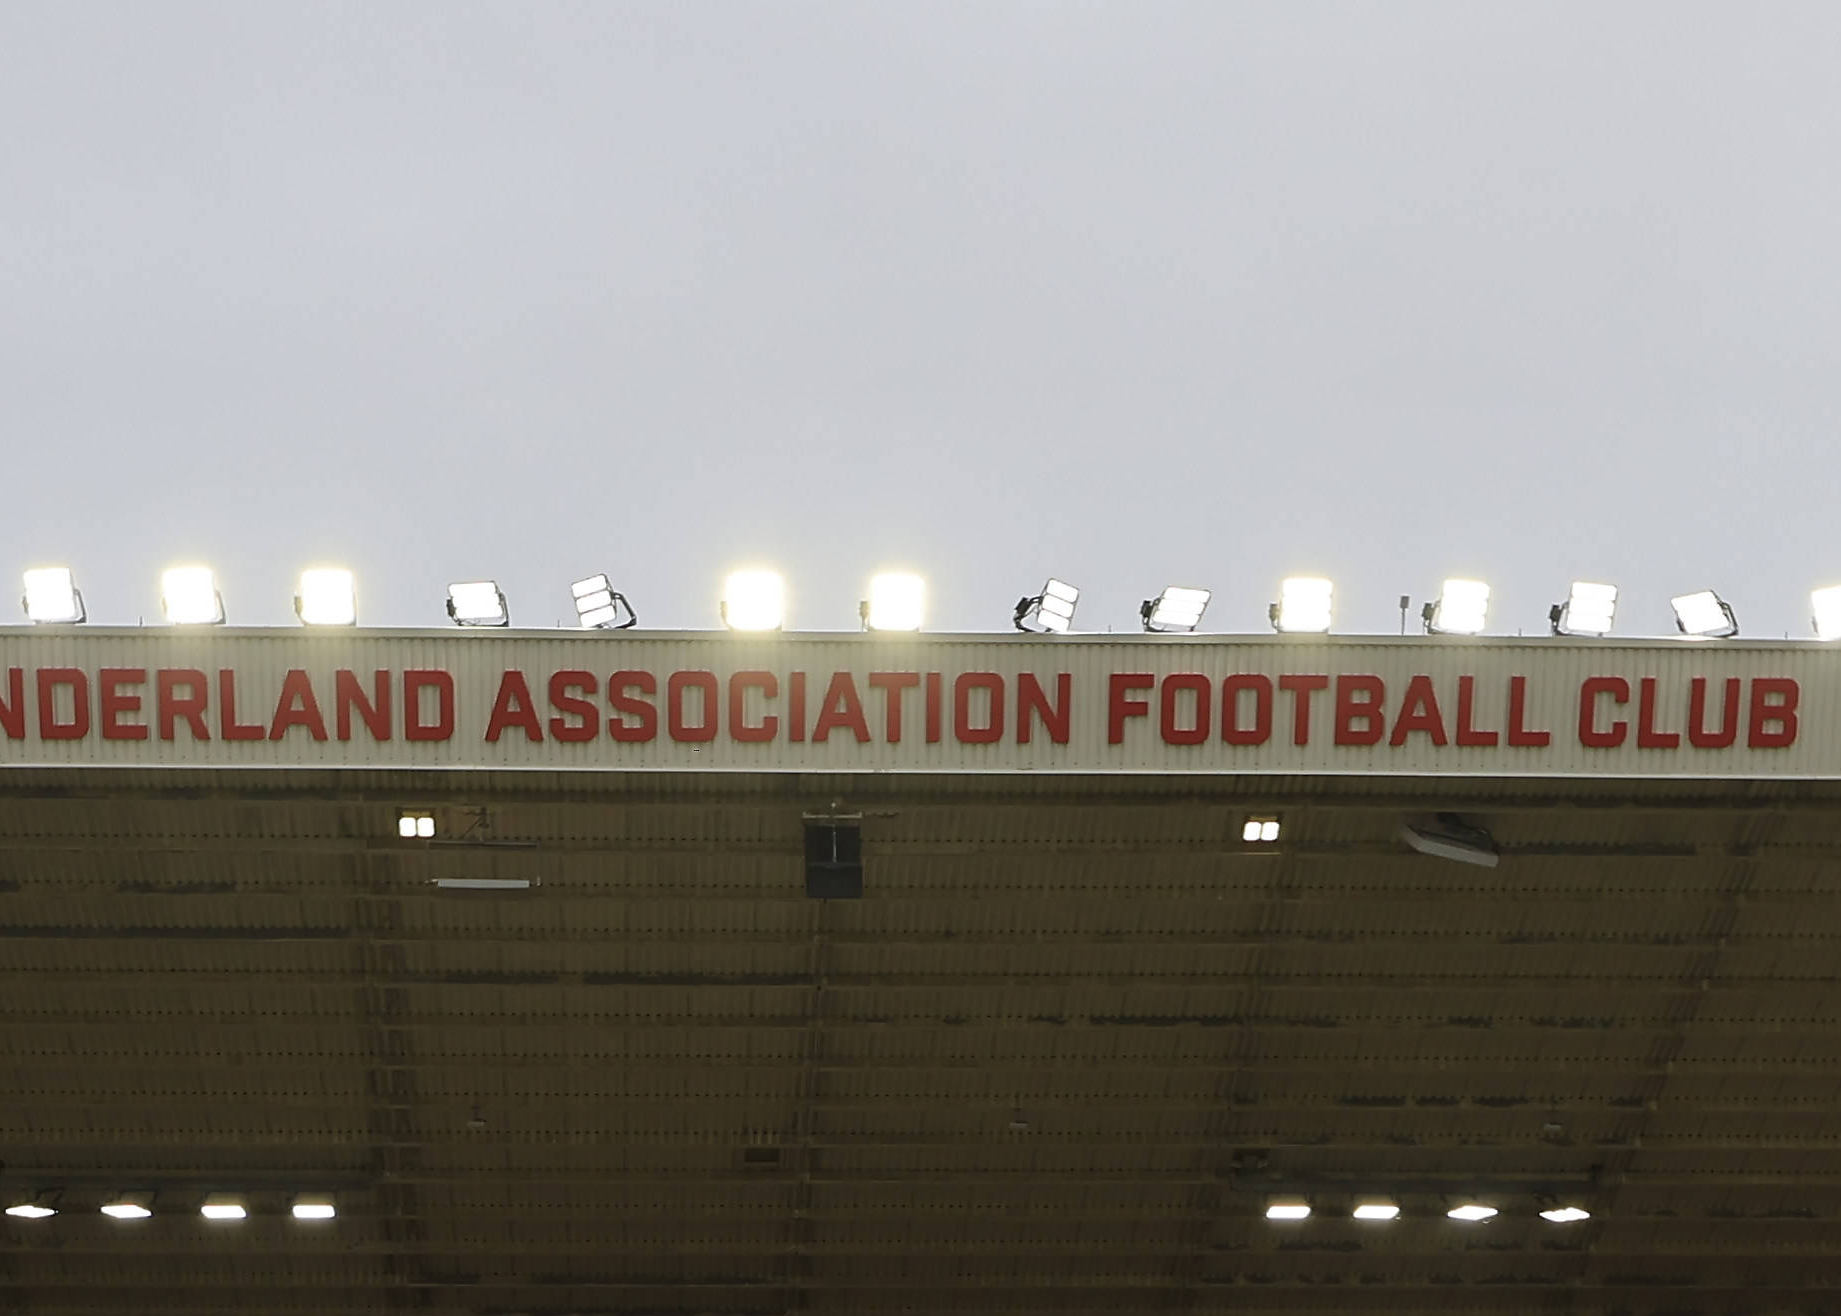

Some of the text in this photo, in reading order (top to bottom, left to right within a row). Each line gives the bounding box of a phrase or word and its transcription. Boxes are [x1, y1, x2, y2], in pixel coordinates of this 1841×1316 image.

[485, 670, 1072, 744] ASSOCIATION
[1107, 673, 1551, 747] FOOTBALL
[1578, 677, 1802, 748] CLUB
